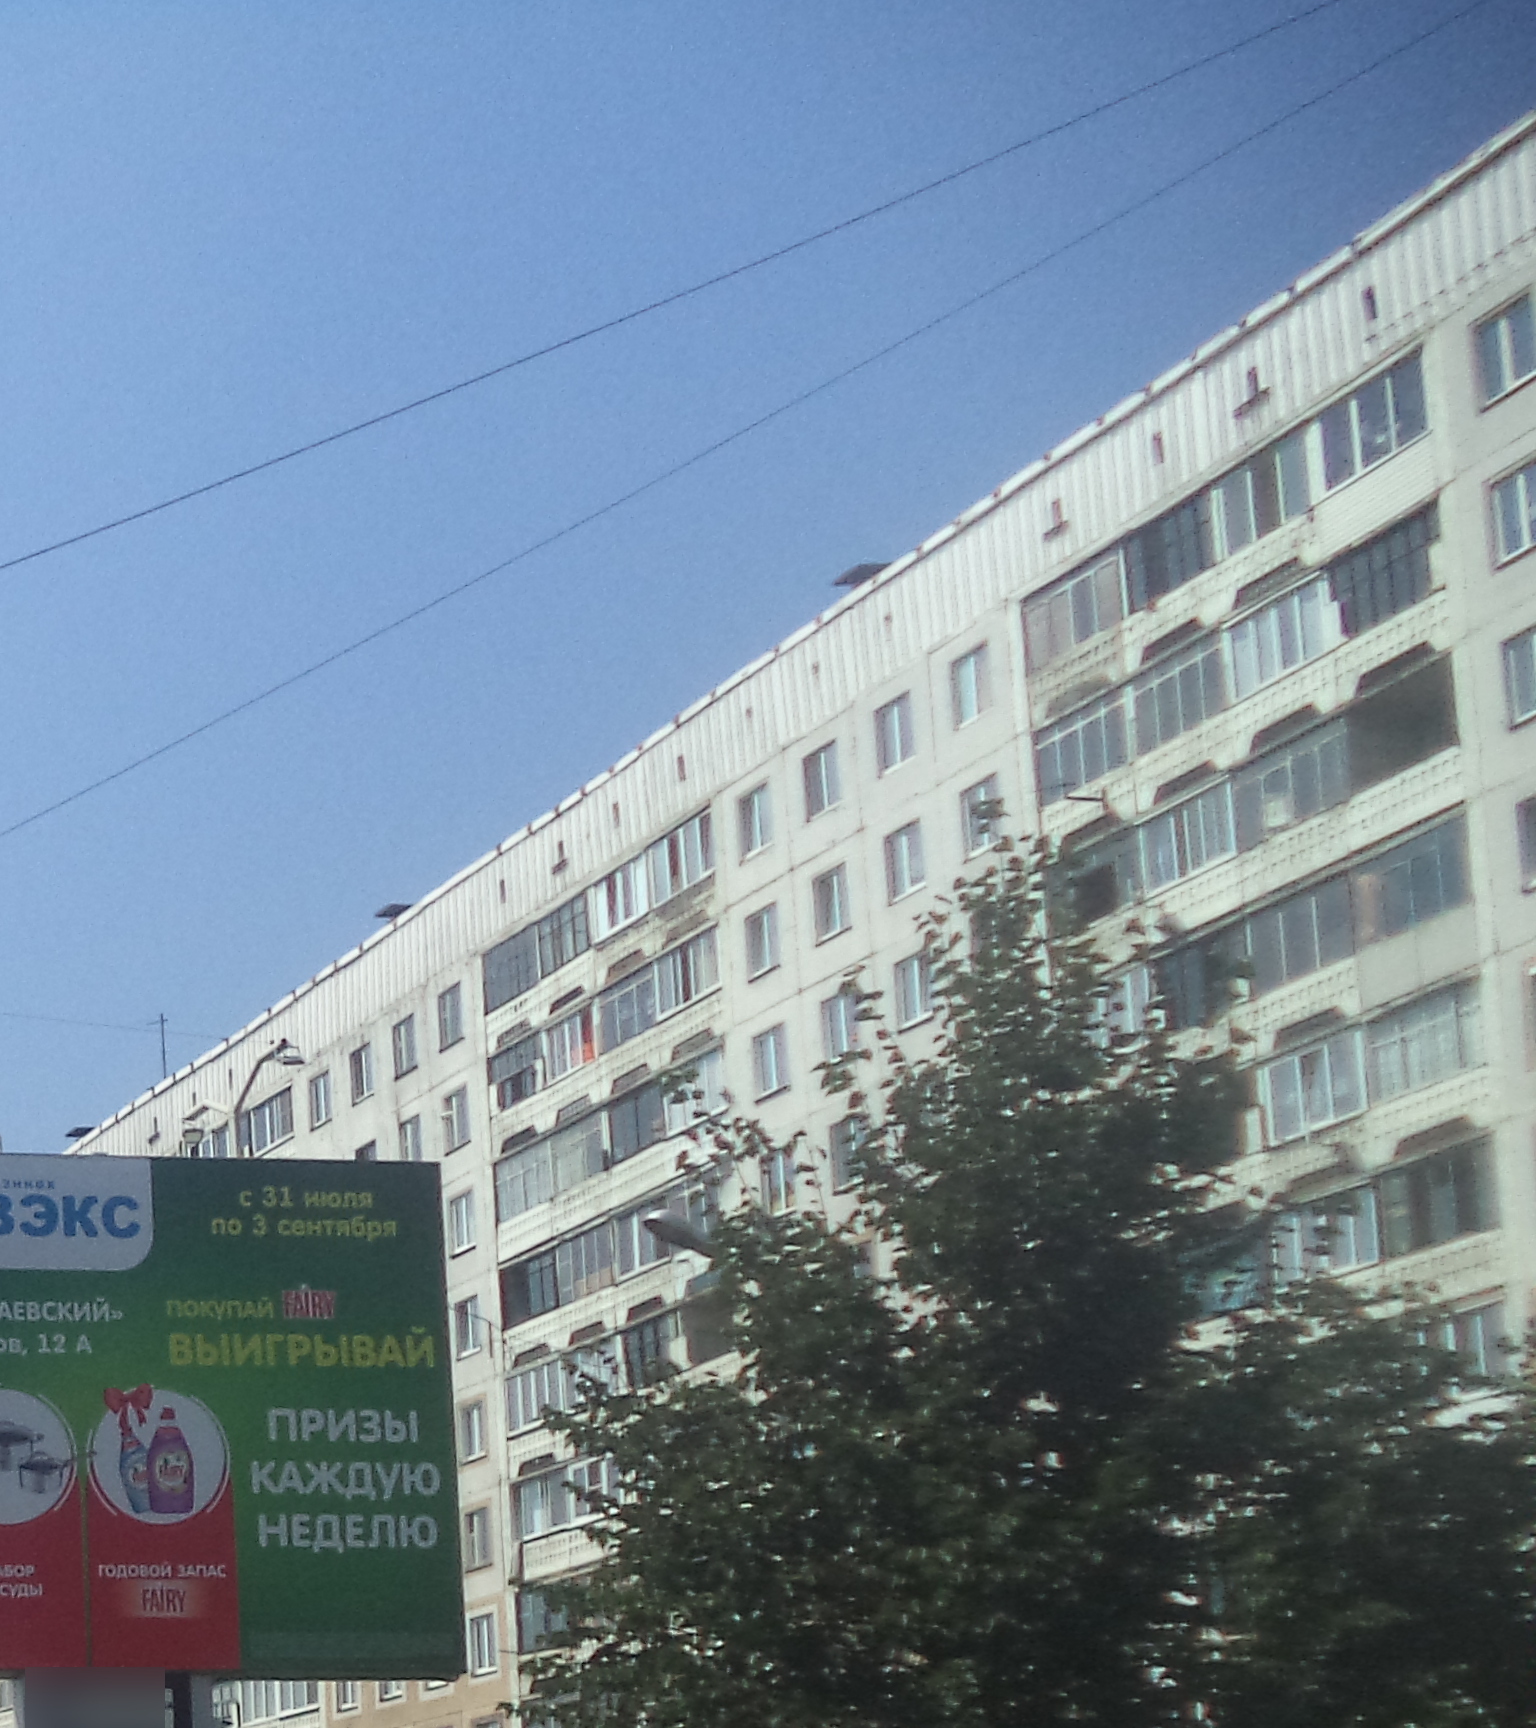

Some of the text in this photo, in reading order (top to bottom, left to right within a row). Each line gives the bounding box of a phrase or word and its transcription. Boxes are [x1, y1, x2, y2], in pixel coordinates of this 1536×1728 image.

[239, 1186, 373, 1209] с 31 июля
[211, 1214, 397, 1241] по 3 сентября
[166, 1297, 274, 1319] ПОКУПАЙ
[38, 1332, 66, 1353] 12
[168, 1326, 435, 1368] ВЫИГРЫВАЙ
[268, 1408, 419, 1443] ПРИЗЫ
[250, 1460, 441, 1500] КАЖДУЮ
[258, 1513, 438, 1553] НЕДЕЛЮ
[98, 1561, 227, 1579] ГОДОВОЙ ЗАПАС
[141, 1584, 187, 1613] FAIRY
